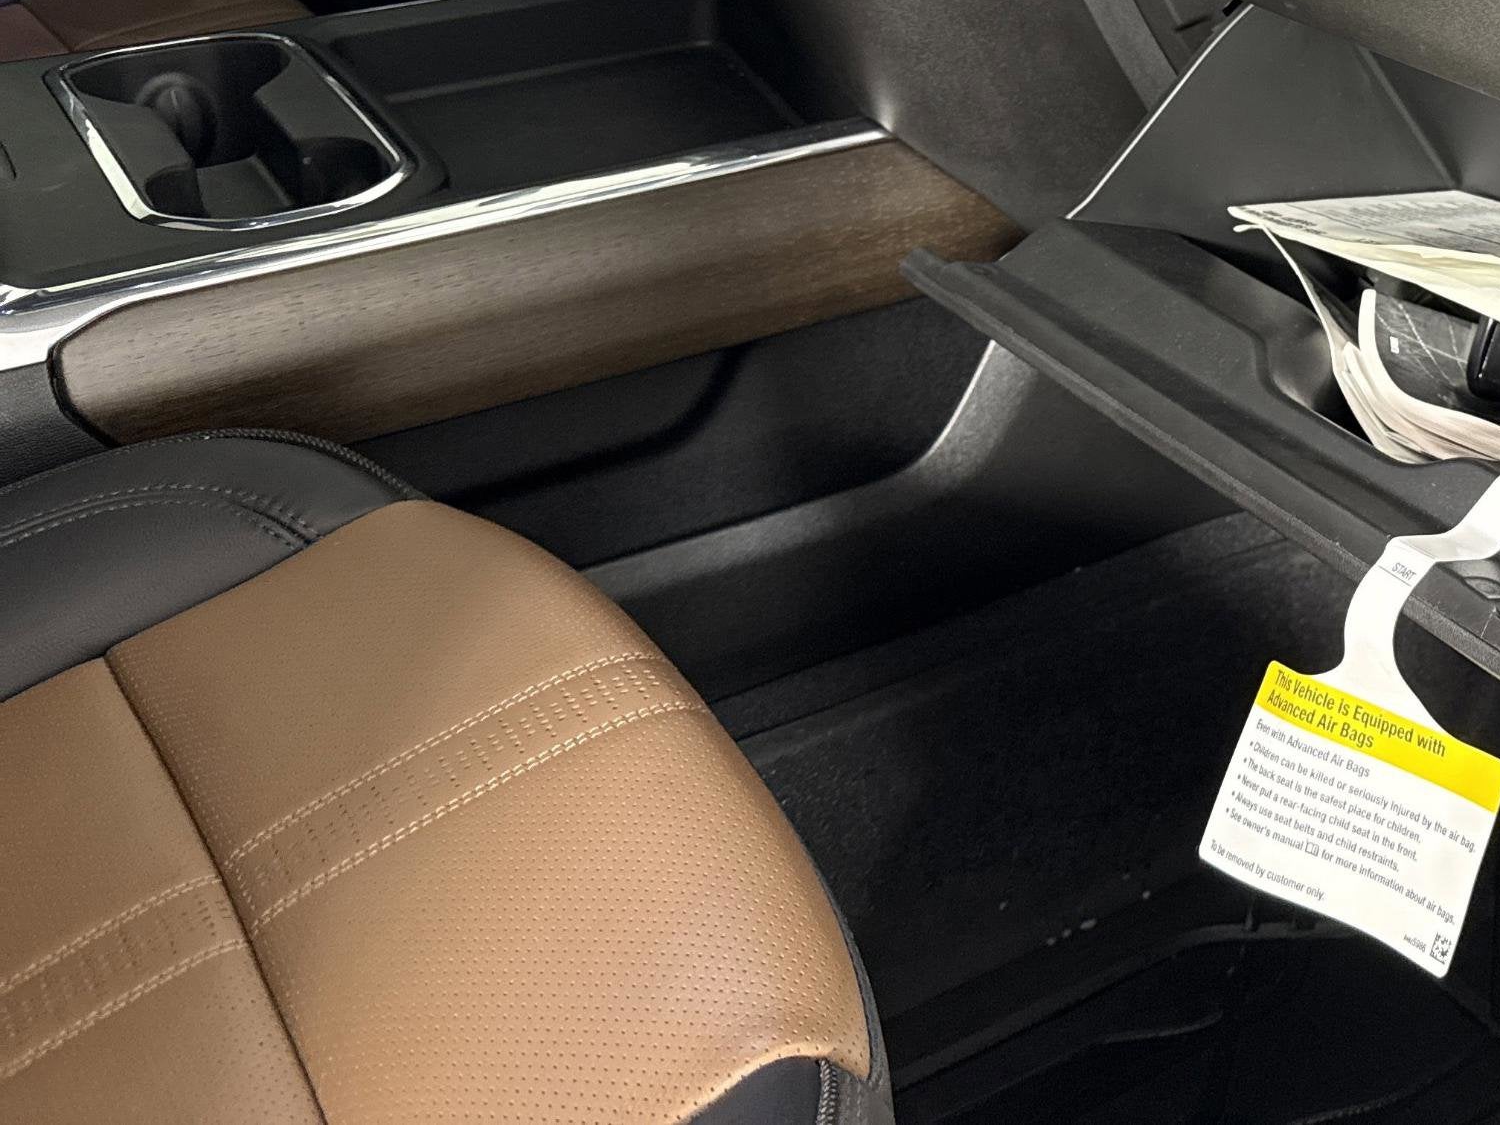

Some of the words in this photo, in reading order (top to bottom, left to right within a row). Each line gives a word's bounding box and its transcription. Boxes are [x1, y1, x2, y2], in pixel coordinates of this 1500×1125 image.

[1392, 562, 1416, 581] START
[1256, 718, 1270, 734] Even
[1271, 729, 1286, 743] with
[1287, 735, 1330, 761] Advanced
[1330, 753, 1344, 768] Air
[1346, 759, 1370, 777] Bags
[1267, 689, 1316, 725] Advanced
[1316, 713, 1338, 733] Air
[1340, 721, 1374, 749] Bags
[1275, 669, 1292, 691] This
[1293, 679, 1335, 711] Vehicle
[1353, 704, 1414, 743] Equipped
[1416, 734, 1446, 757] with
[1234, 791, 1258, 811] Always
[1258, 805, 1273, 819] use
[1274, 813, 1293, 828] seat
[1294, 819, 1316, 836] belts
[1316, 829, 1334, 843] and
[1335, 836, 1358, 853] child
[1358, 845, 1399, 873] restraints.
[1242, 774, 1260, 792] Never
[1260, 787, 1272, 799] put
[1272, 793, 1278, 803] a
[1280, 796, 1327, 823] rear-facing
[1328, 815, 1351, 831] child
[1352, 825, 1371, 839] seat
[1372, 830, 1380, 843] in
[1382, 835, 1396, 851] the
[1396, 841, 1418, 861] front.
[1248, 757, 1258, 772] The
[1259, 765, 1275, 781] back
[1276, 775, 1294, 789] seat
[1295, 781, 1302, 793] is
[1304, 786, 1318, 799] the
[1320, 793, 1347, 810] safest
[1348, 803, 1372, 820] place
[1373, 813, 1386, 827] for
[1387, 819, 1421, 843] children.
[1254, 741, 1280, 763] Children
[1280, 757, 1296, 771] can
[1297, 763, 1308, 776] be
[1310, 768, 1336, 787] killed
[1336, 779, 1347, 791] or
[1348, 785, 1389, 810] seriously
[1390, 800, 1421, 823] injured
[1422, 815, 1432, 831] by
[1434, 821, 1448, 836] the
[1448, 830, 1460, 843] air
[1460, 835, 1476, 853] bag.
[1218, 843, 1226, 857] be
[1226, 851, 1256, 872] removed
[1256, 864, 1266, 879] by
[1266, 870, 1306, 892] customer
[1306, 885, 1325, 901] only.
[1230, 807, 1242, 823] See
[1242, 817, 1271, 837] owner's
[1272, 831, 1304, 851] manual
[1321, 849, 1334, 863] for
[1335, 855, 1358, 872] more
[1359, 863, 1404, 895] information
[1405, 887, 1427, 907] about
[1426, 900, 1436, 913] air
